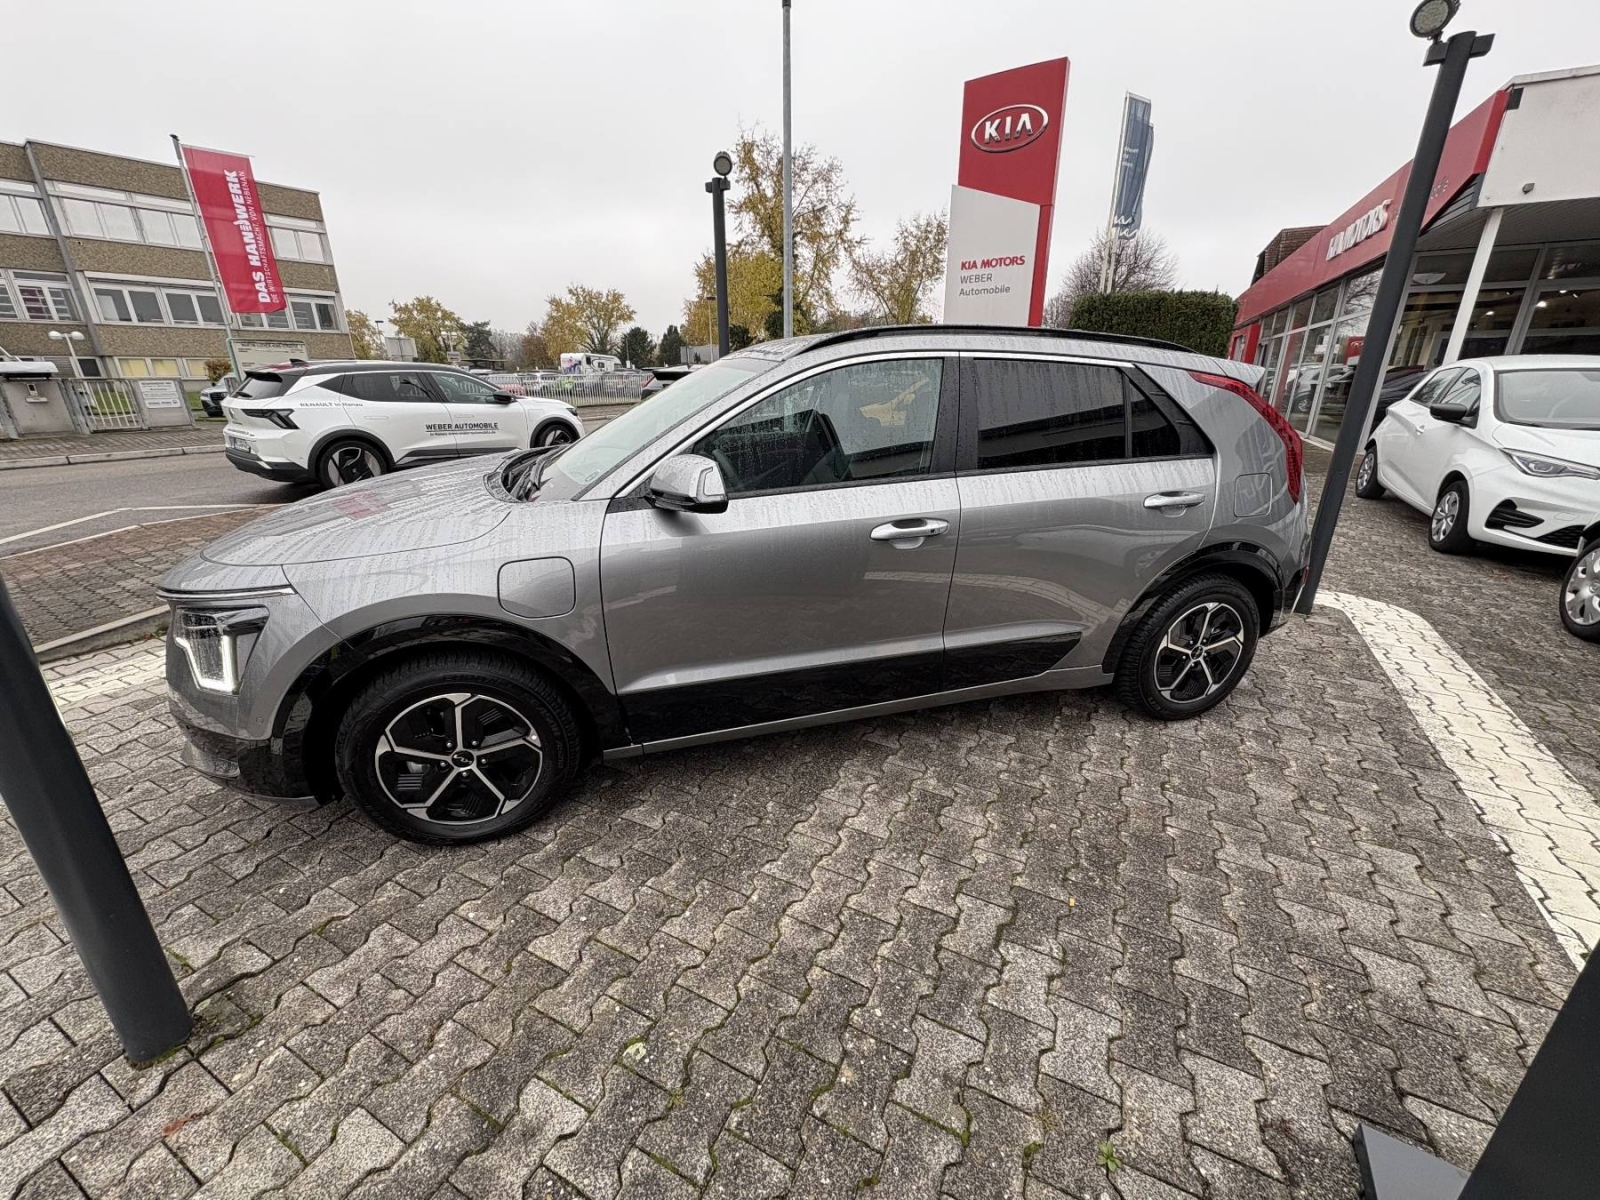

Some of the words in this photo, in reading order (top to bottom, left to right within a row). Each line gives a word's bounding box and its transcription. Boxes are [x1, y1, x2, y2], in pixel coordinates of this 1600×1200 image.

[984, 113, 1033, 143] KIA
[247, 204, 257, 222] VON
[1342, 199, 1393, 253] MOTORS
[961, 260, 978, 271] KIA
[980, 255, 1026, 269] MOTORS
[252, 271, 271, 303] DAS
[960, 273, 993, 285] WEBER
[959, 284, 1011, 297] Automobile
[425, 423, 452, 431] WEBER
[454, 422, 499, 430] AUTOMOBILE
